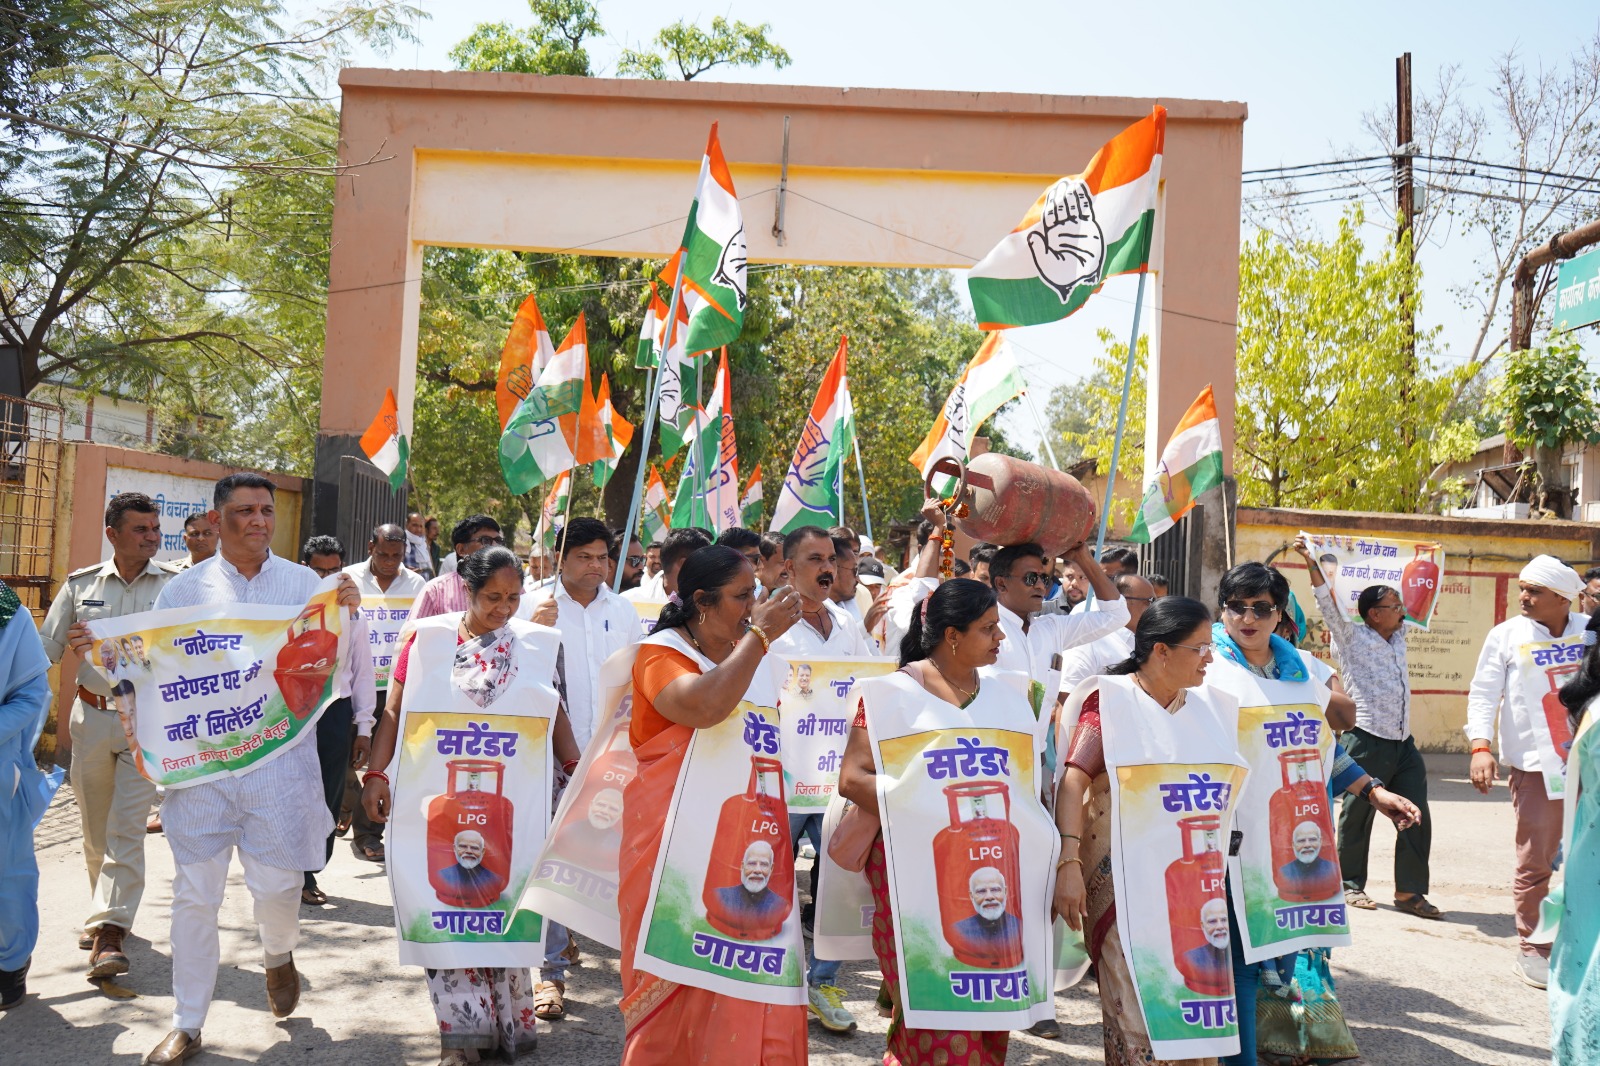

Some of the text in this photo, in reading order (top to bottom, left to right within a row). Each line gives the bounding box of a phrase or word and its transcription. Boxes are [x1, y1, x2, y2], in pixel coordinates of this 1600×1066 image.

[1559, 275, 1586, 312] कार्यालय
[166, 502, 190, 518] बचत
[1373, 542, 1382, 556] के
[1382, 546, 1398, 557] दाम
[1341, 566, 1355, 577] कम
[1373, 568, 1387, 580] कम
[1387, 567, 1403, 581] करो
[1408, 578, 1434, 589] LPG
[377, 606, 388, 620] के
[159, 659, 263, 702] सरेण्डर घर में
[164, 713, 201, 742] नहीं
[797, 713, 816, 736] भी
[162, 754, 196, 772] जिला
[231, 735, 263, 758] कमेटी
[264, 717, 290, 741] बैतूल
[437, 721, 518, 757] सरेंडर
[818, 750, 836, 772] भी
[795, 781, 820, 796] जिला
[457, 813, 487, 825] LPG
[1295, 803, 1320, 817] LPG
[751, 819, 779, 835] LPG
[969, 845, 1003, 861] LPG
[431, 911, 505, 934] गायब
[1275, 903, 1346, 929] गायब
[694, 932, 786, 975] गायब
